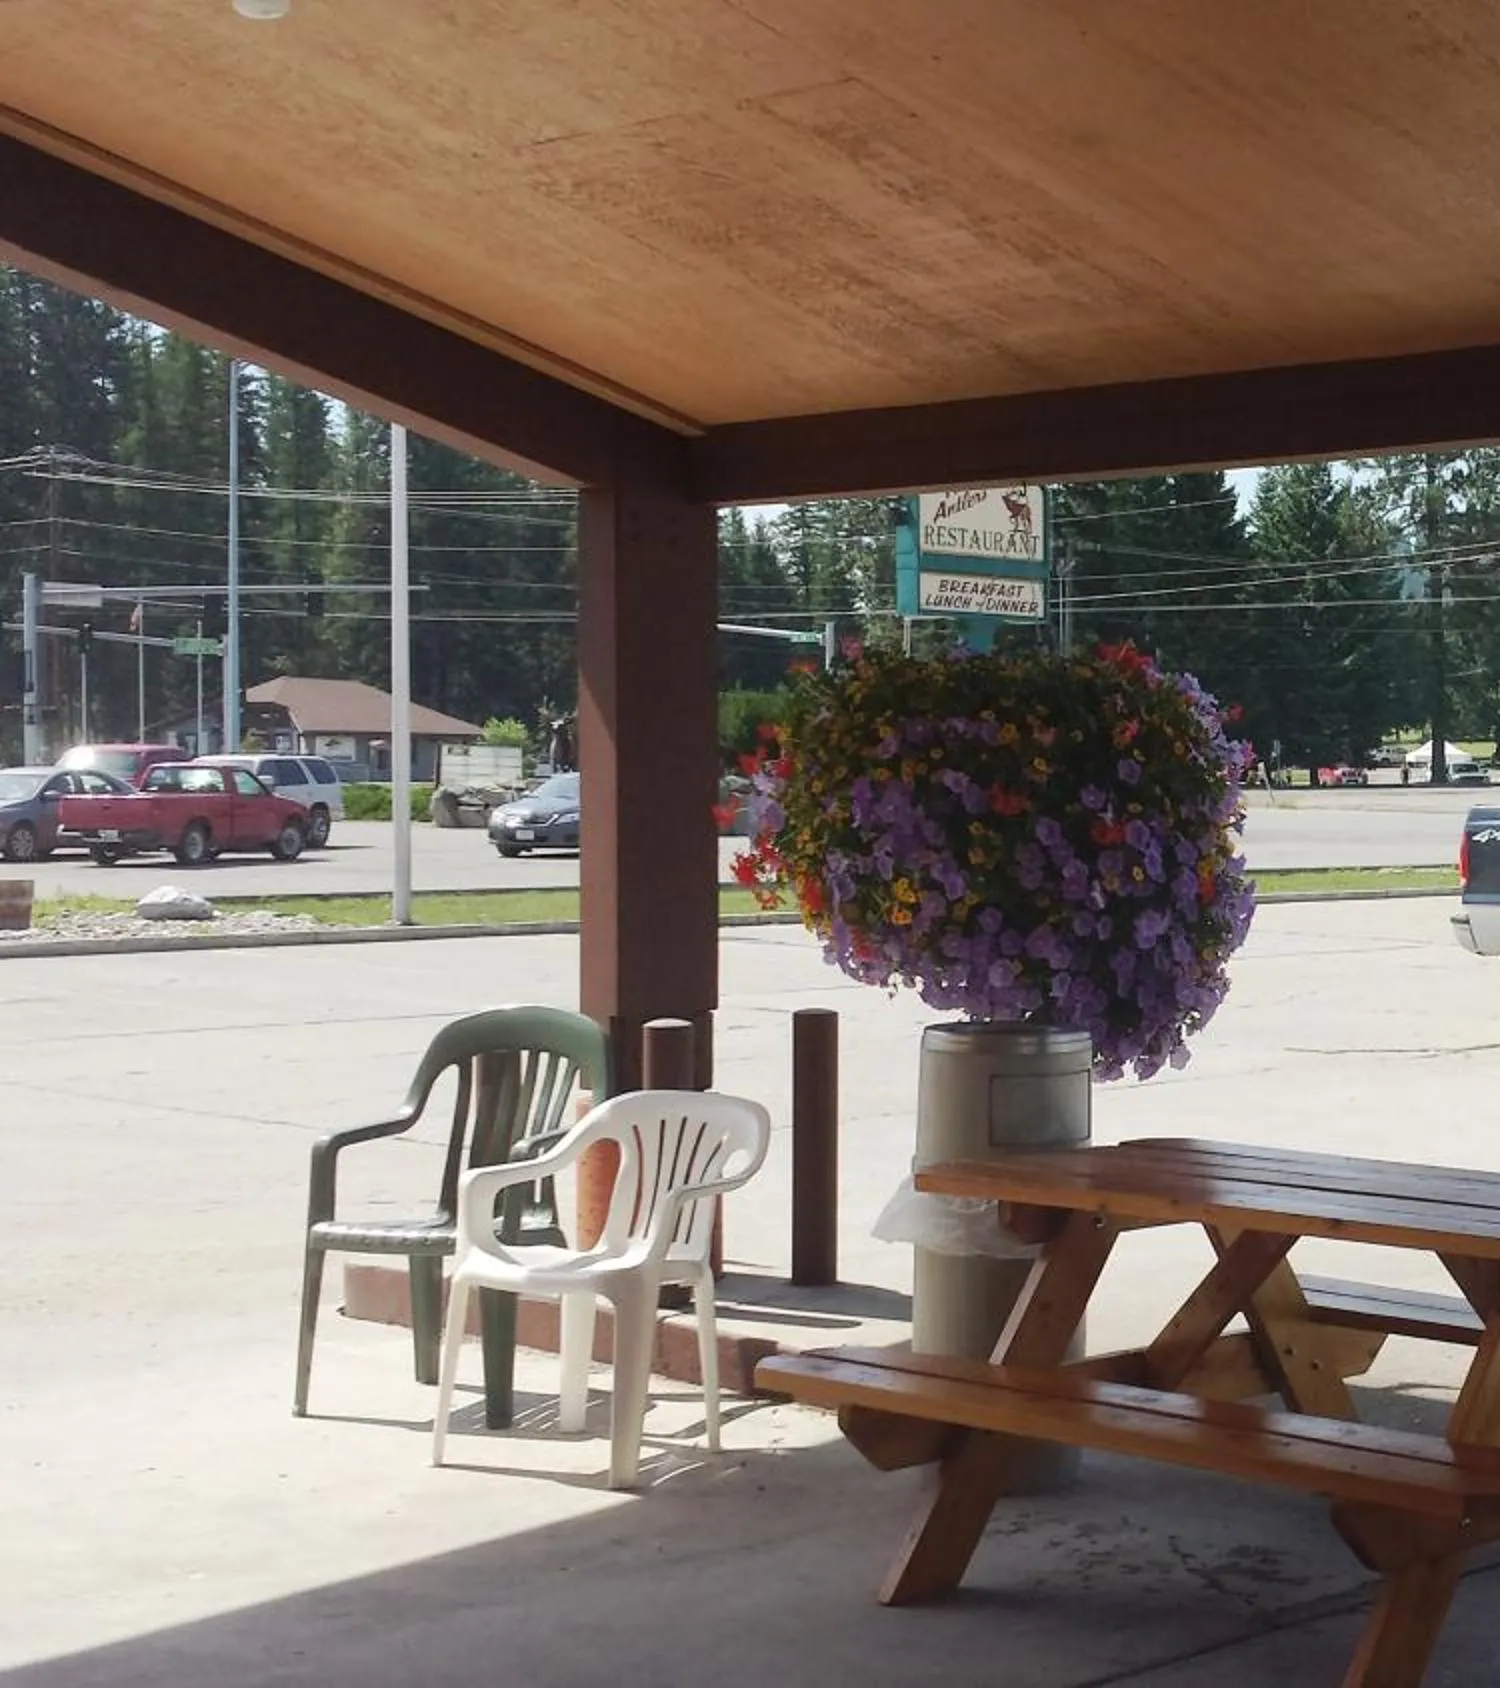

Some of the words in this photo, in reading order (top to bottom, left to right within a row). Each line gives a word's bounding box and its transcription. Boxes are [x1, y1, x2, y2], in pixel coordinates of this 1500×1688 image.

[924, 525, 1038, 555] RESTAURANT
[938, 579, 1025, 597] BREAKFAST
[925, 593, 972, 609] LUNCH
